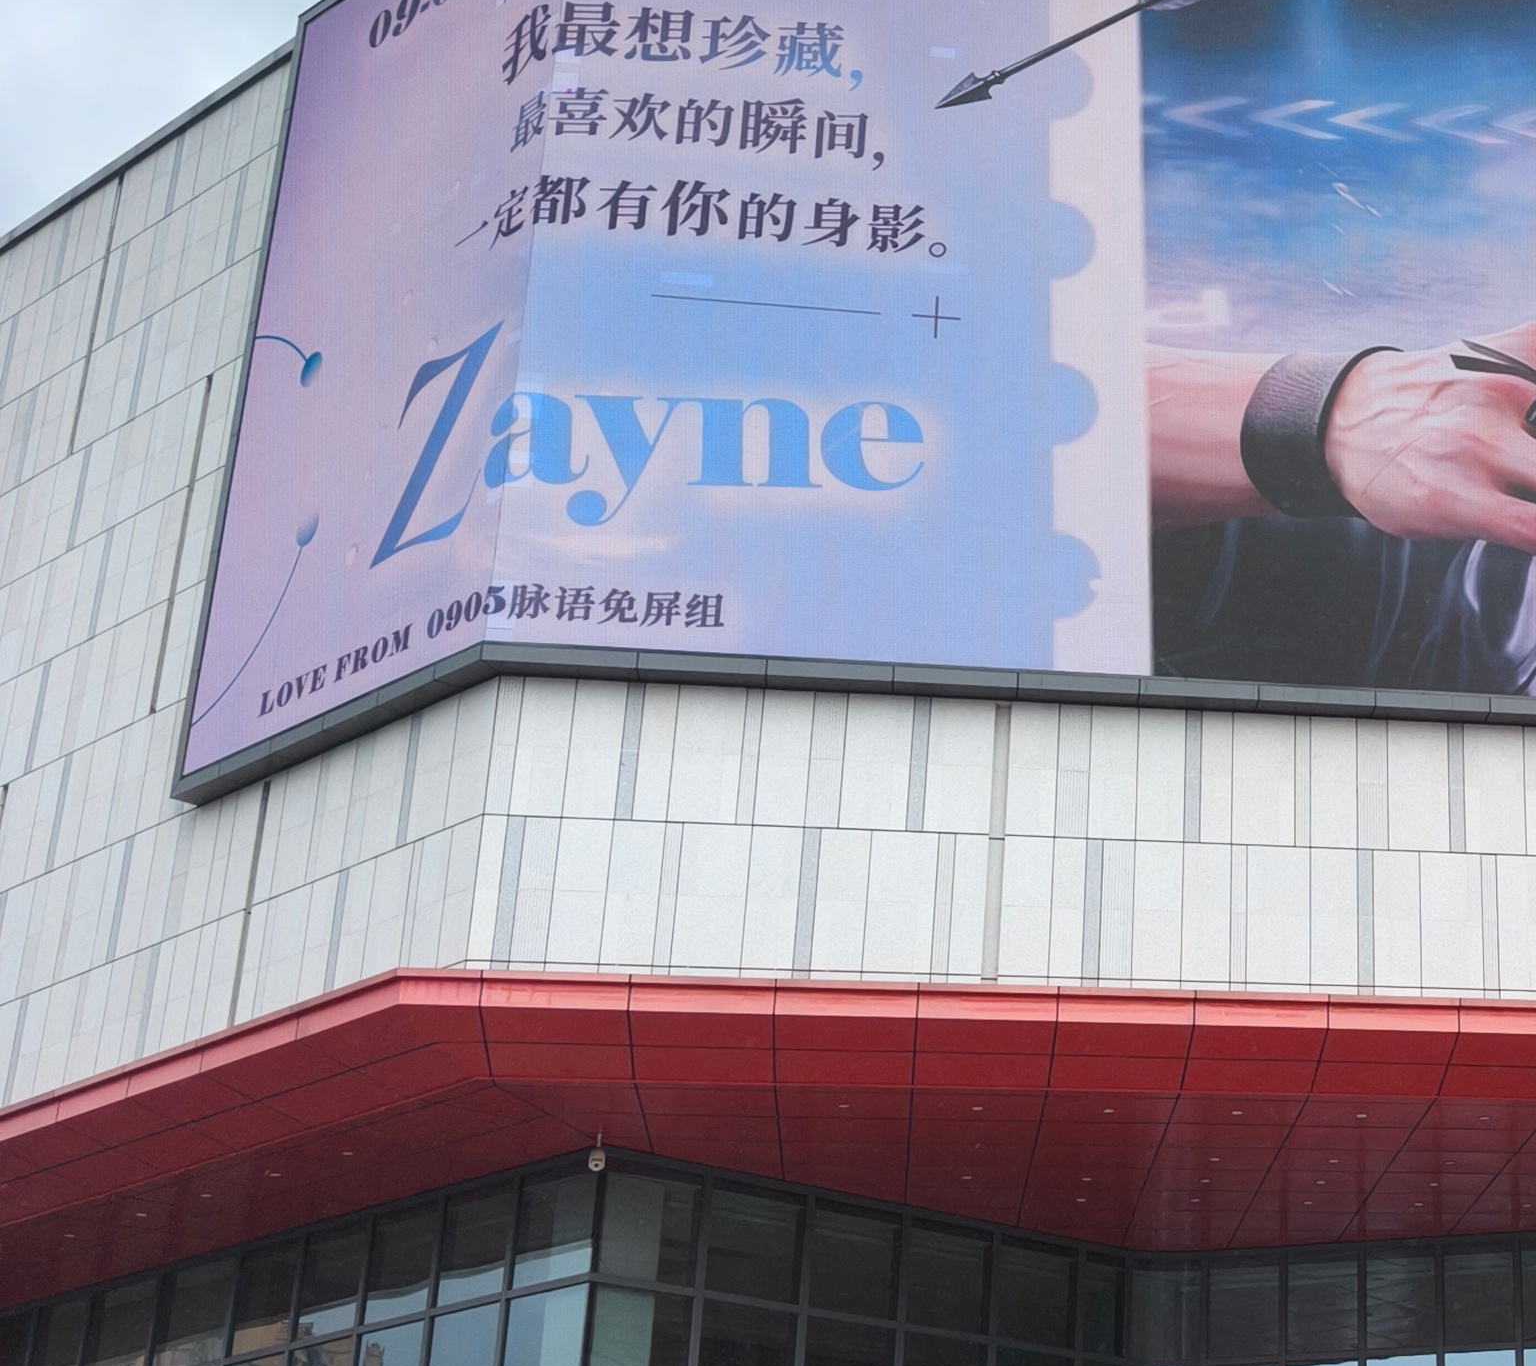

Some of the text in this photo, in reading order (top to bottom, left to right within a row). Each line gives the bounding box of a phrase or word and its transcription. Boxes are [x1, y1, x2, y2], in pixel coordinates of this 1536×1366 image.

[369, 319, 925, 570] Zayne
[258, 664, 327, 718] LOVE
[333, 623, 414, 685] FROM
